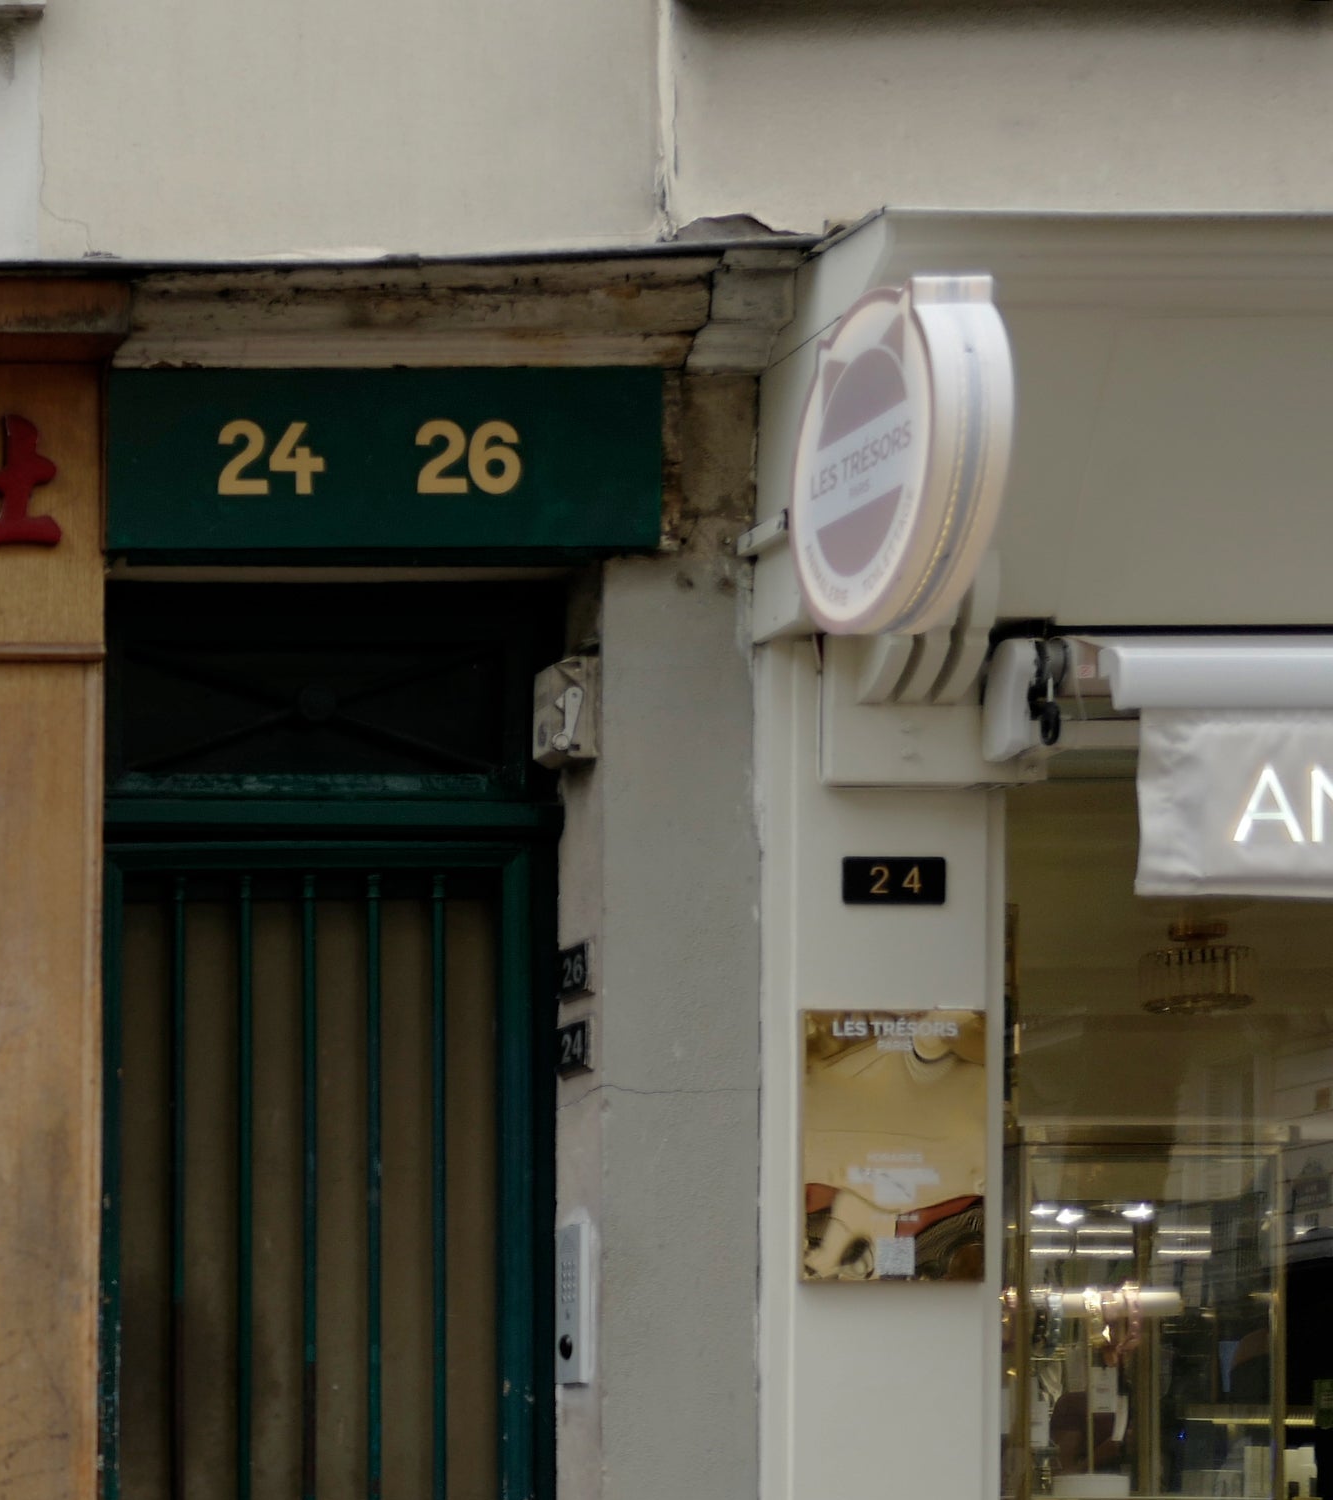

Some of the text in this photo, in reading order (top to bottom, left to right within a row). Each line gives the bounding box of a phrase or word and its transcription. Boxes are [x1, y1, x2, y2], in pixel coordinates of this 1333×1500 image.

[217, 419, 522, 495] 24 26
[810, 420, 912, 501] LES TRÉSORS
[869, 867, 923, 894] 24
[563, 954, 584, 988] 26
[832, 1017, 959, 1037] LES TRÉSORS
[561, 1029, 583, 1064] 24
